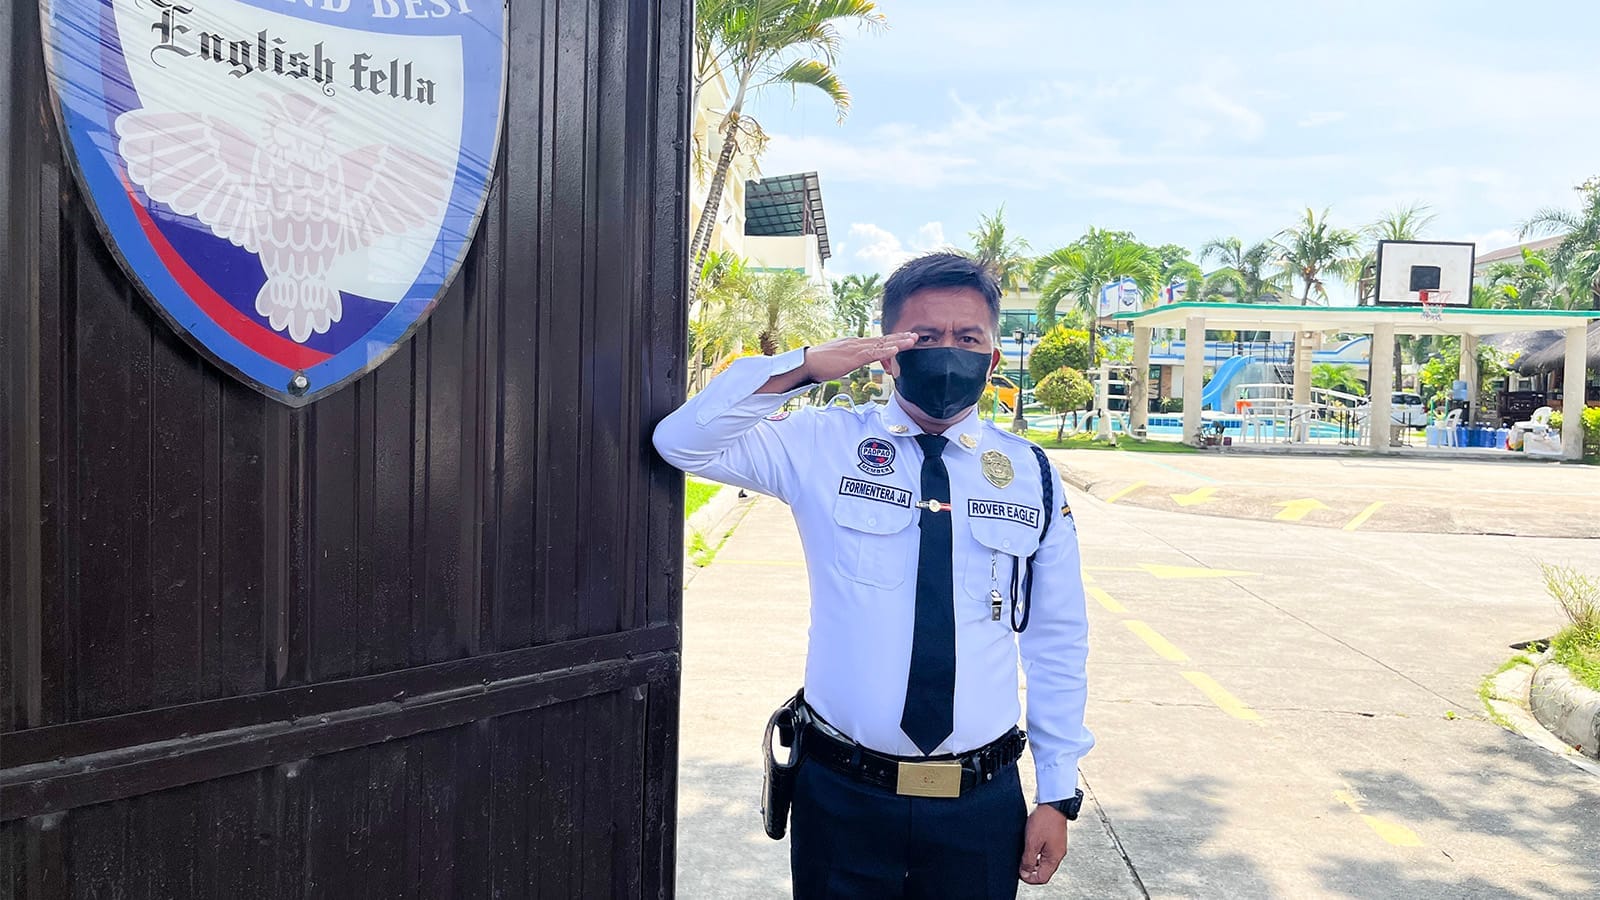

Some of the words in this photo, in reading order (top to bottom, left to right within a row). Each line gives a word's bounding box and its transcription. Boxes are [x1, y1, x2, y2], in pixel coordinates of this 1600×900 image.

[135, 0, 336, 97] English
[349, 52, 437, 105] fella
[861, 464, 890, 474] MEMBER
[844, 481, 895, 502] FORMENTERA
[897, 492, 907, 504] JA
[972, 502, 1005, 516] ROVER
[1007, 506, 1035, 524] EAGLE
